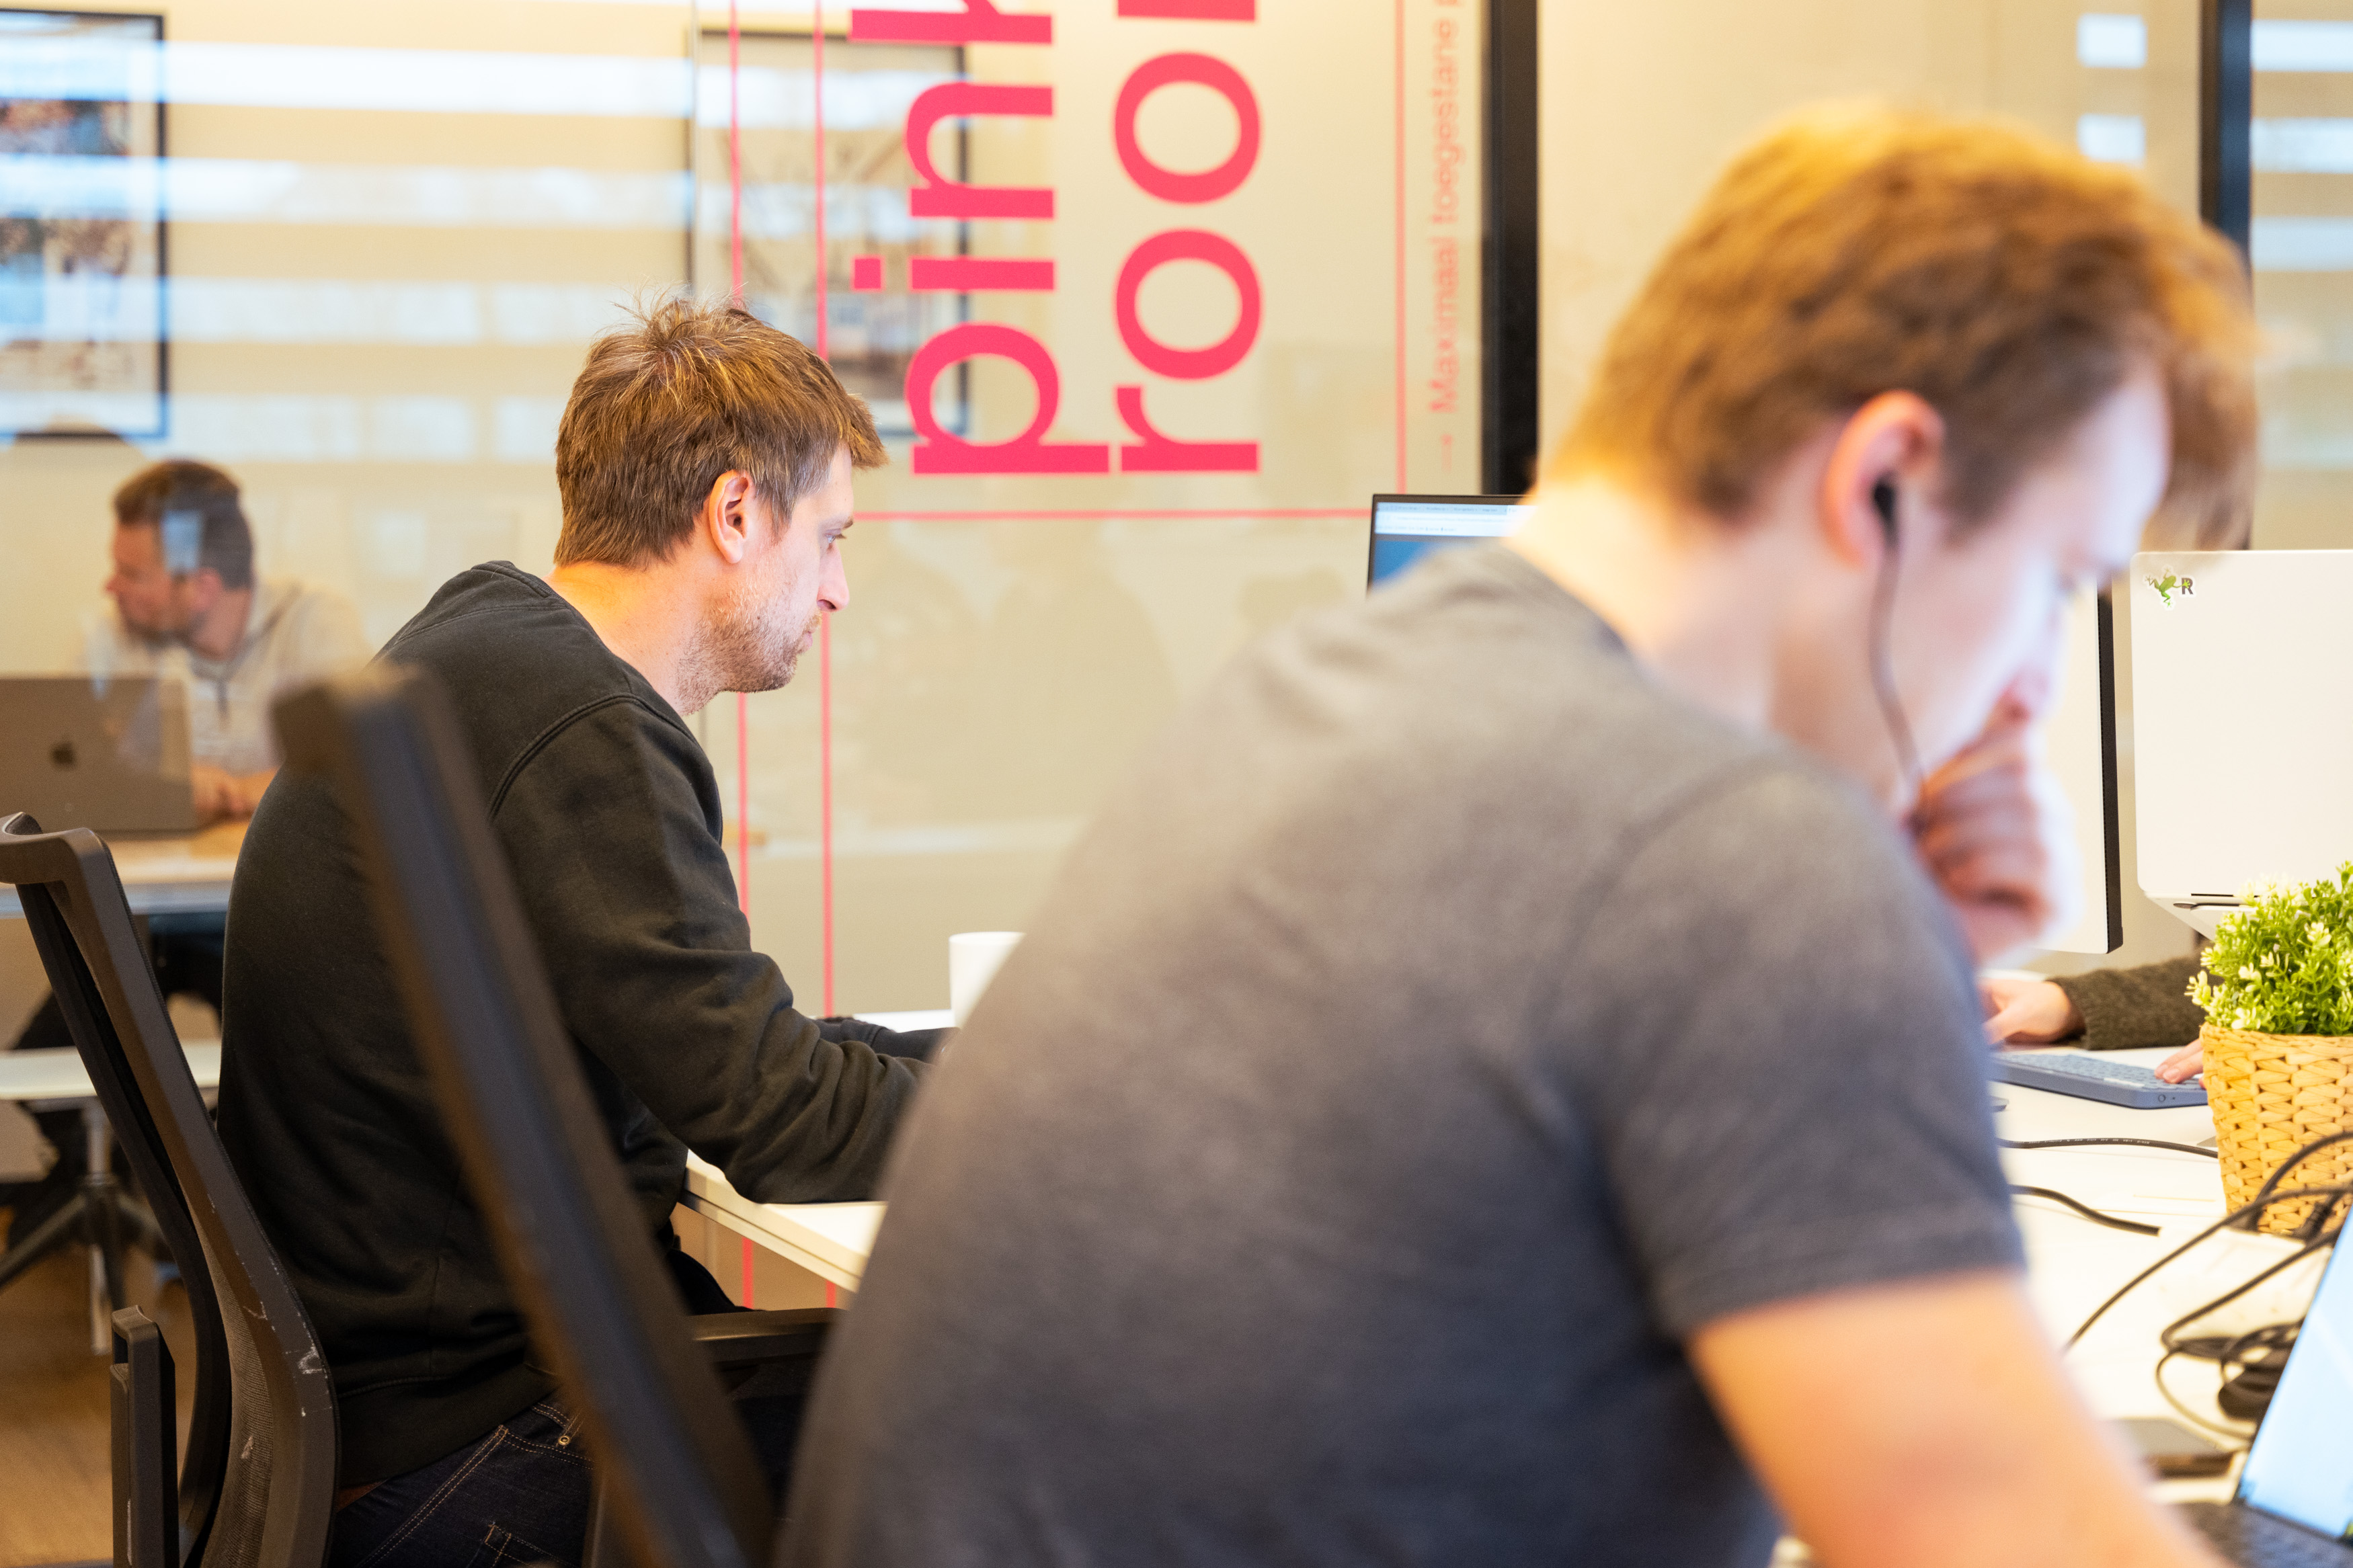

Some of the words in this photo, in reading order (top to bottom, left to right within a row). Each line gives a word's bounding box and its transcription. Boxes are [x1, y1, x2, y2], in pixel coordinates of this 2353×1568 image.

[1115, 0, 1261, 472] roo
[1427, 236, 1460, 413] Maximaal
[2182, 577, 2194, 595] R
